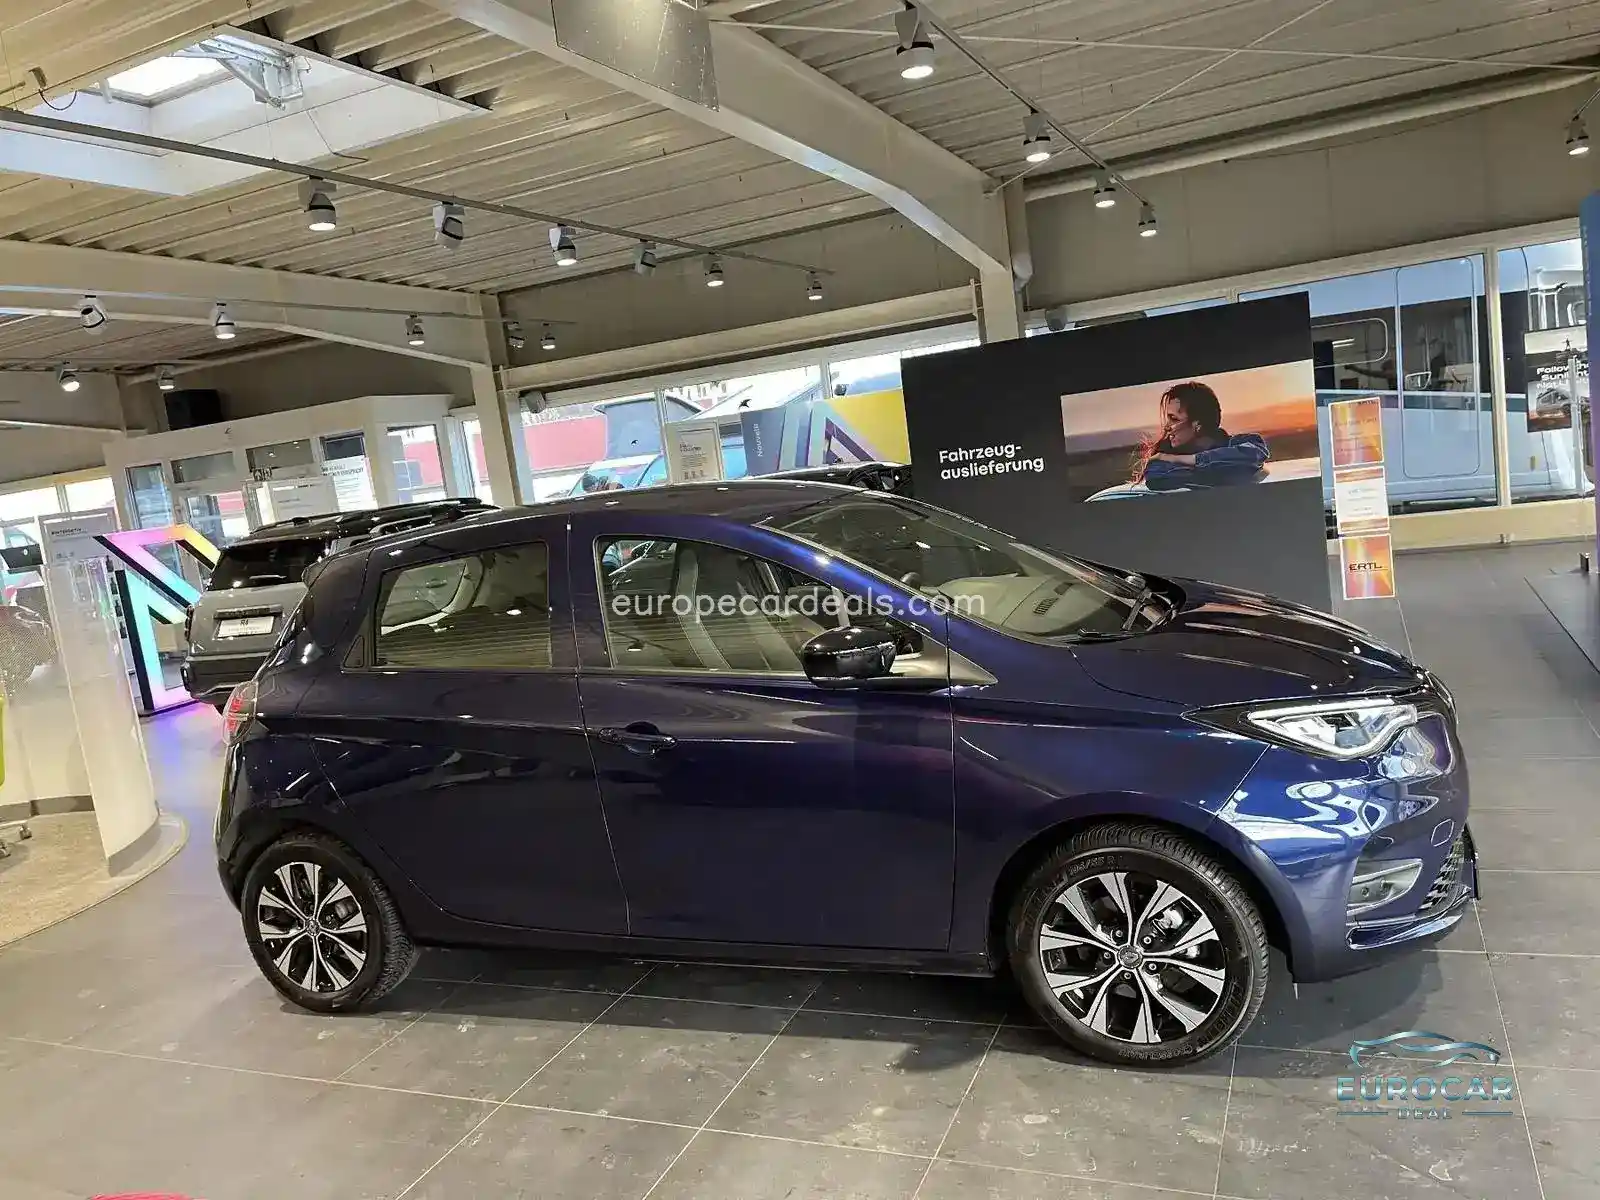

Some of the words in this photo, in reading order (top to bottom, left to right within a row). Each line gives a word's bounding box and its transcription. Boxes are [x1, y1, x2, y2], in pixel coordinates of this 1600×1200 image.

[938, 444, 1022, 464] Fahrzeug-
[940, 457, 1044, 480] auslieferung
[1349, 562, 1382, 571] ERTL
